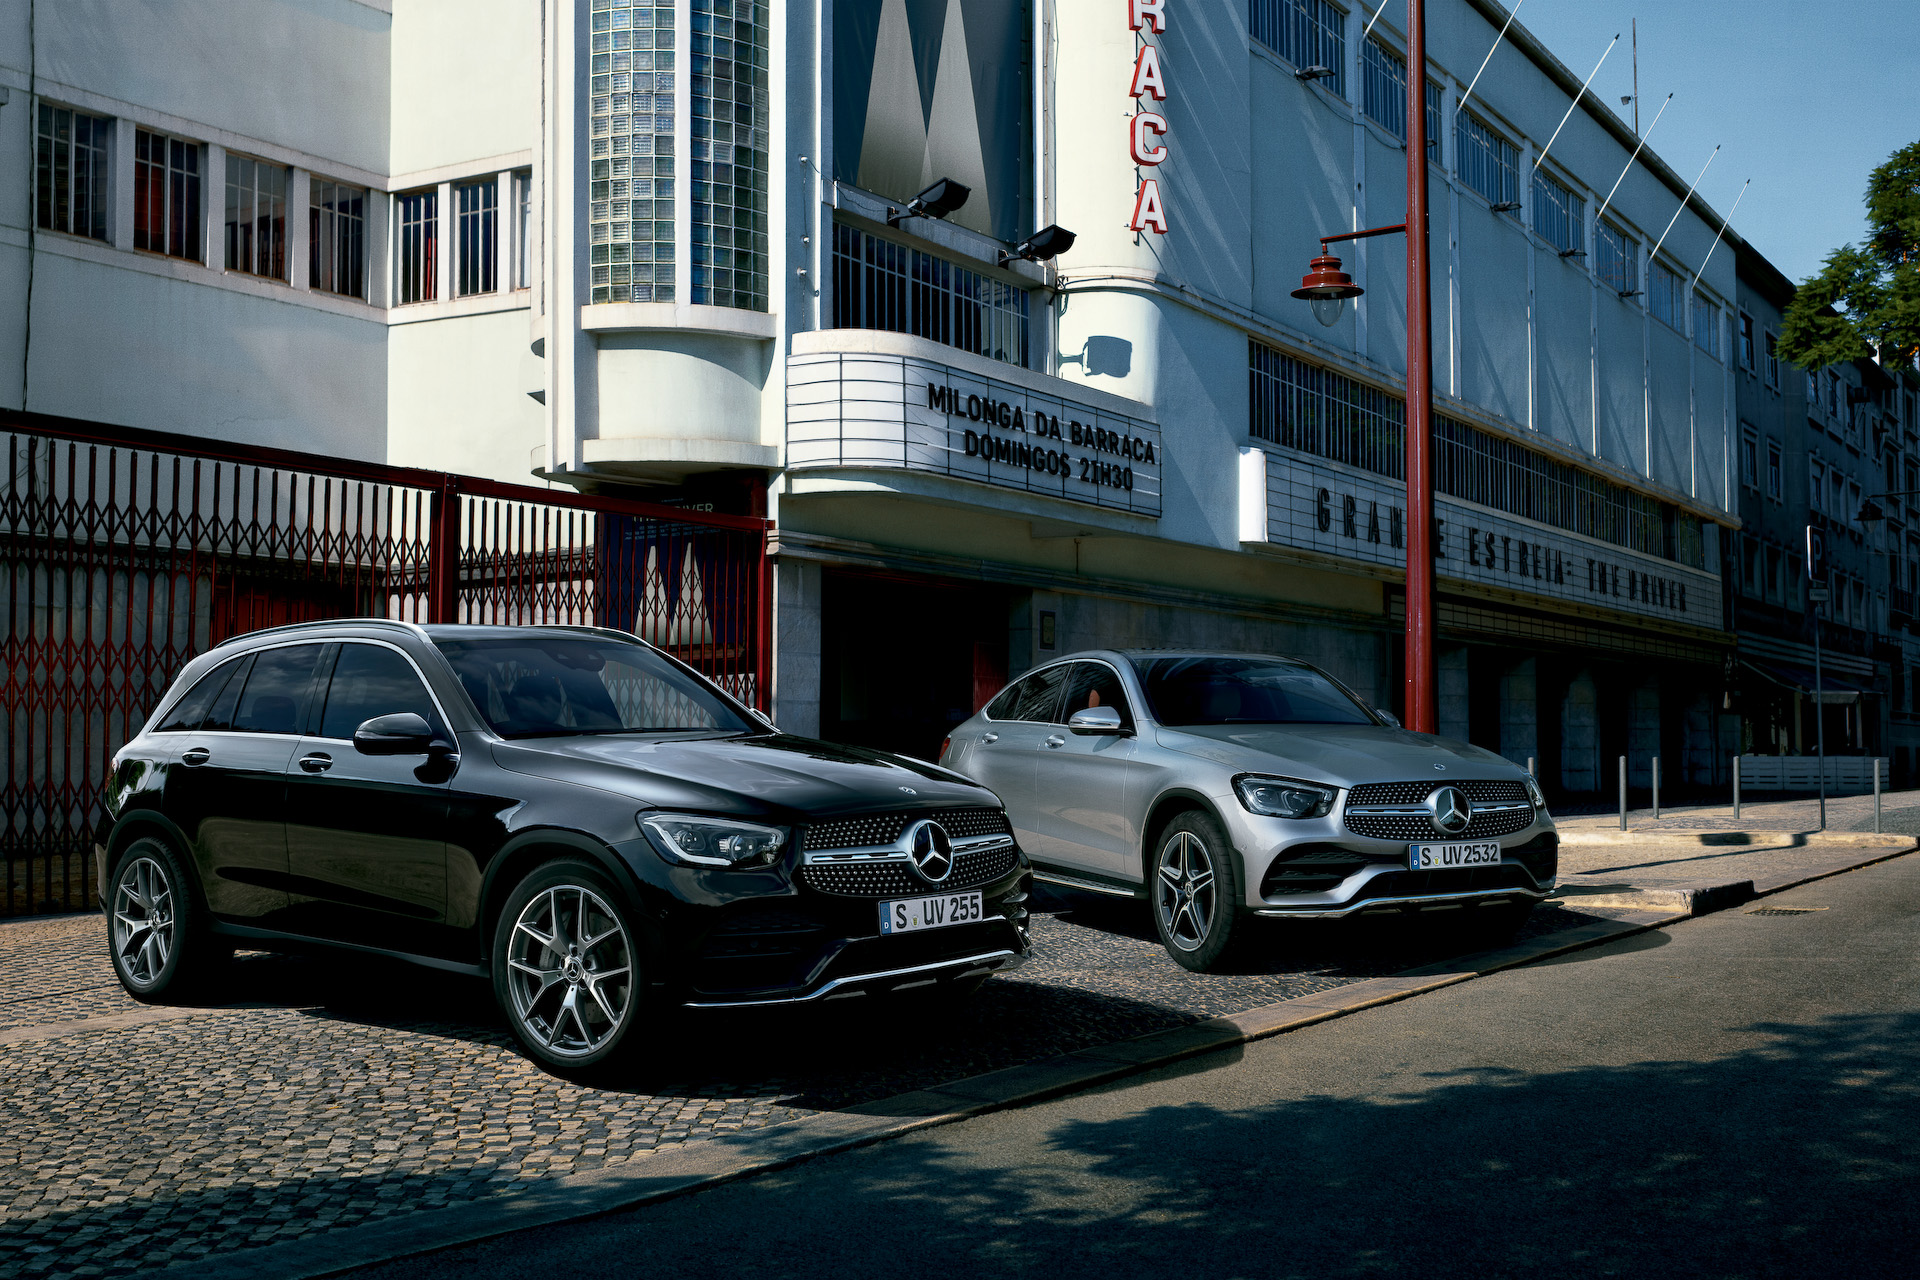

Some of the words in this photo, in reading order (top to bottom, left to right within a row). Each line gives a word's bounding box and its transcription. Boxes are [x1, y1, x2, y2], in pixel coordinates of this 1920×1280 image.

[928, 382, 1025, 433] MILONGA
[1035, 410, 1062, 441] DA
[1070, 420, 1156, 465] BARRACA
[965, 429, 1071, 478] DOMINGOS
[1079, 457, 1134, 492] 21H30
[1317, 487, 1446, 559] GRANE
[1587, 558, 1620, 598] THE
[1813, 534, 1823, 576] P
[1421, 847, 1432, 867] S
[895, 903, 908, 930] S
[923, 899, 945, 926] UV
[949, 895, 980, 922] 255
